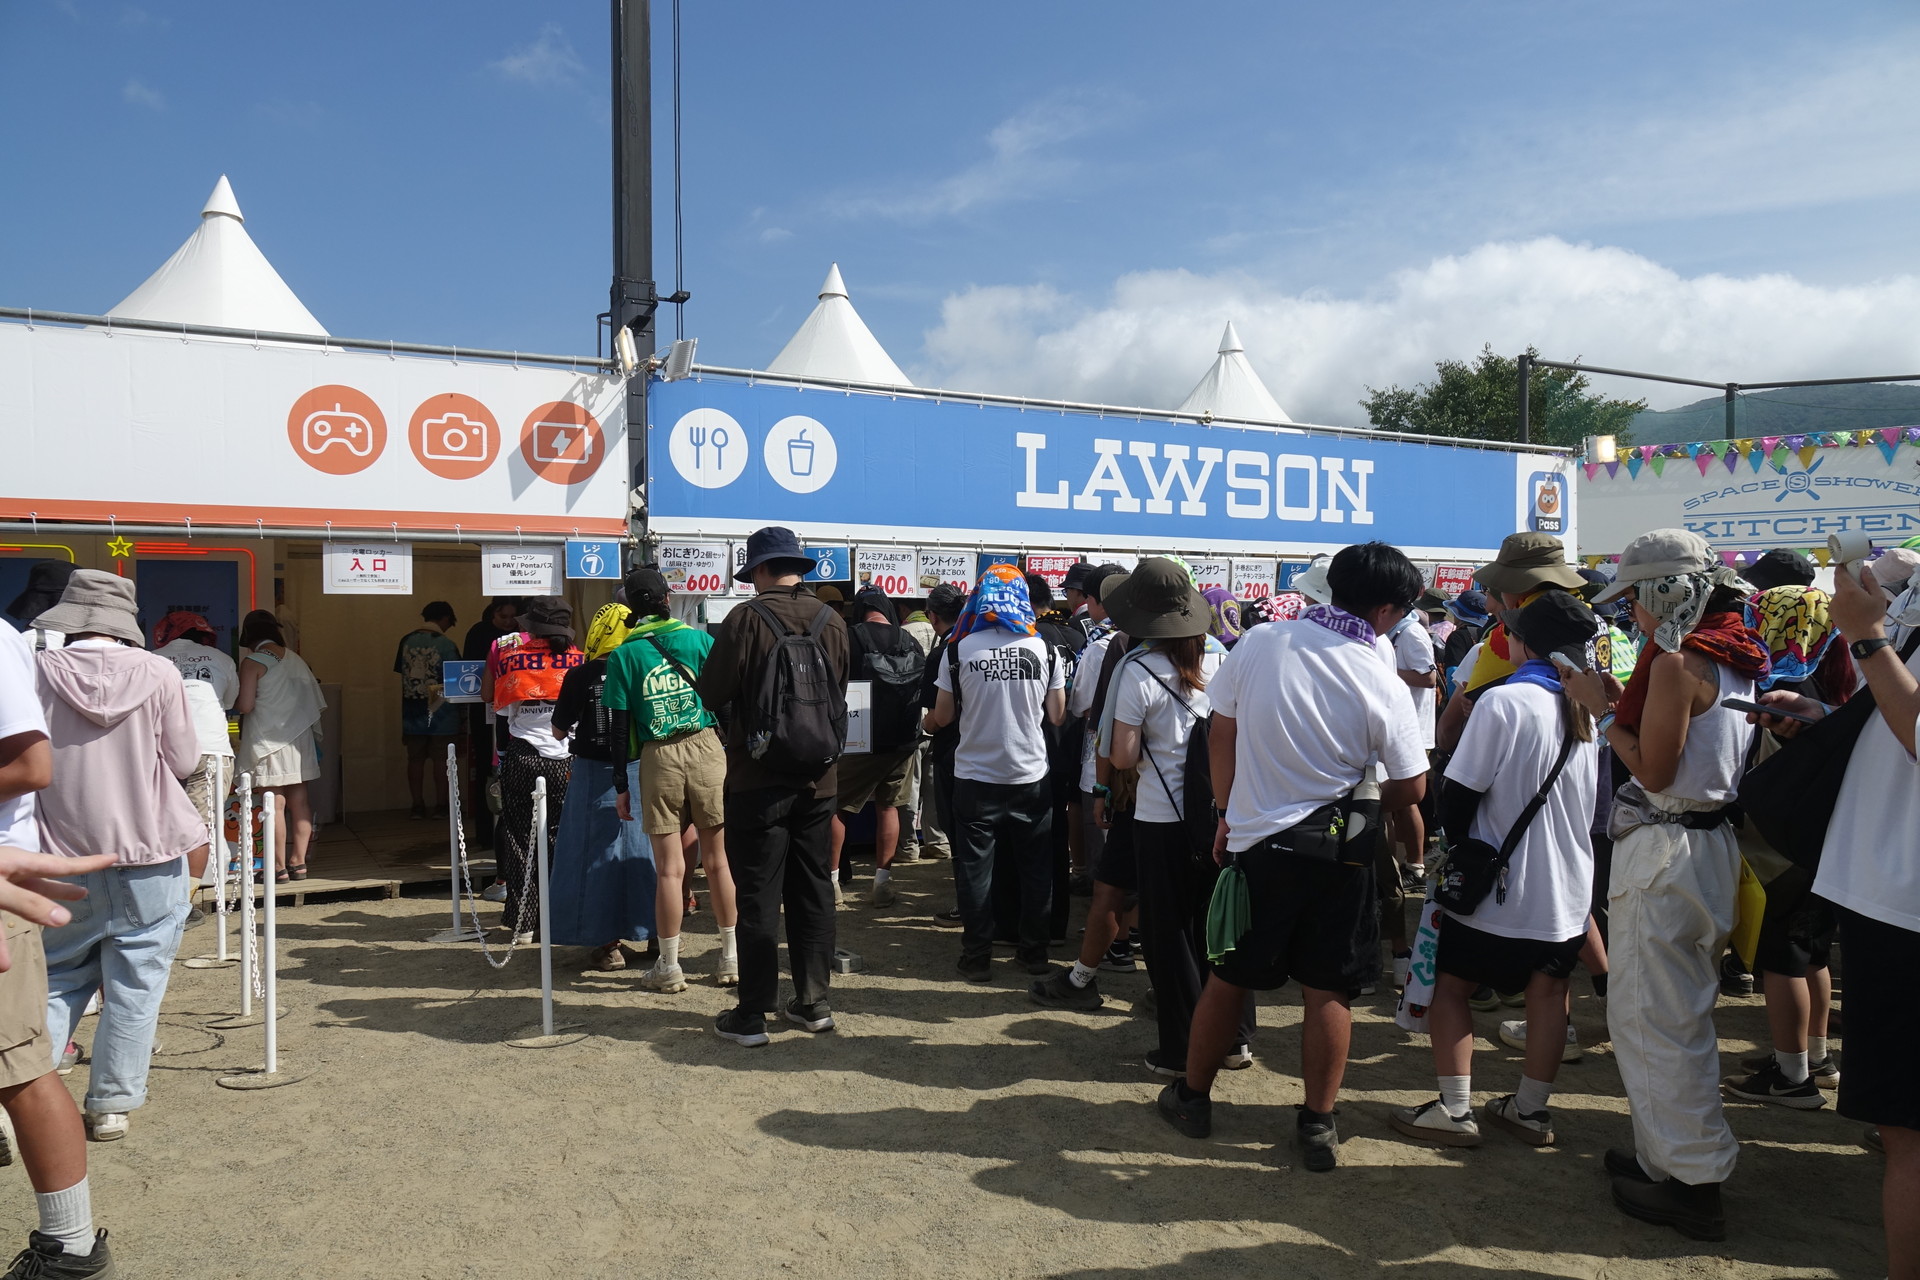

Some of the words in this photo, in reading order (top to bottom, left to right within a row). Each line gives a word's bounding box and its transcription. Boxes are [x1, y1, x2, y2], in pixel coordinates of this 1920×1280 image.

[1016, 432, 1375, 525] LAWSON
[1683, 479, 1780, 510] SPACE
[1538, 519, 1559, 530] Pass
[352, 548, 392, 557] 充電ロッカー
[583, 545, 600, 553] レジ
[818, 550, 833, 558] レジ
[859, 552, 912, 561] プレミアムおにぎり
[921, 555, 966, 567] サンドイッチ
[350, 558, 387, 571] 入口
[859, 563, 896, 571] 焼さけハラミ
[1030, 558, 1075, 571] 年齢確認
[1191, 564, 1227, 575] モンサワー
[923, 568, 966, 576] ハムたまごBOX
[1439, 568, 1473, 580] 年齢確認
[1441, 581, 1465, 593] 実施中
[989, 648, 1017, 658] THE
[461, 664, 478, 673] レジ
[497, 653, 545, 677] BEA
[969, 659, 1018, 672] NORTH
[984, 669, 1018, 682] FACE
[650, 673, 690, 694] MGA
[521, 706, 553, 715] ANNIVER
[653, 693, 696, 717] ミセス
[650, 709, 701, 735] グリーン
